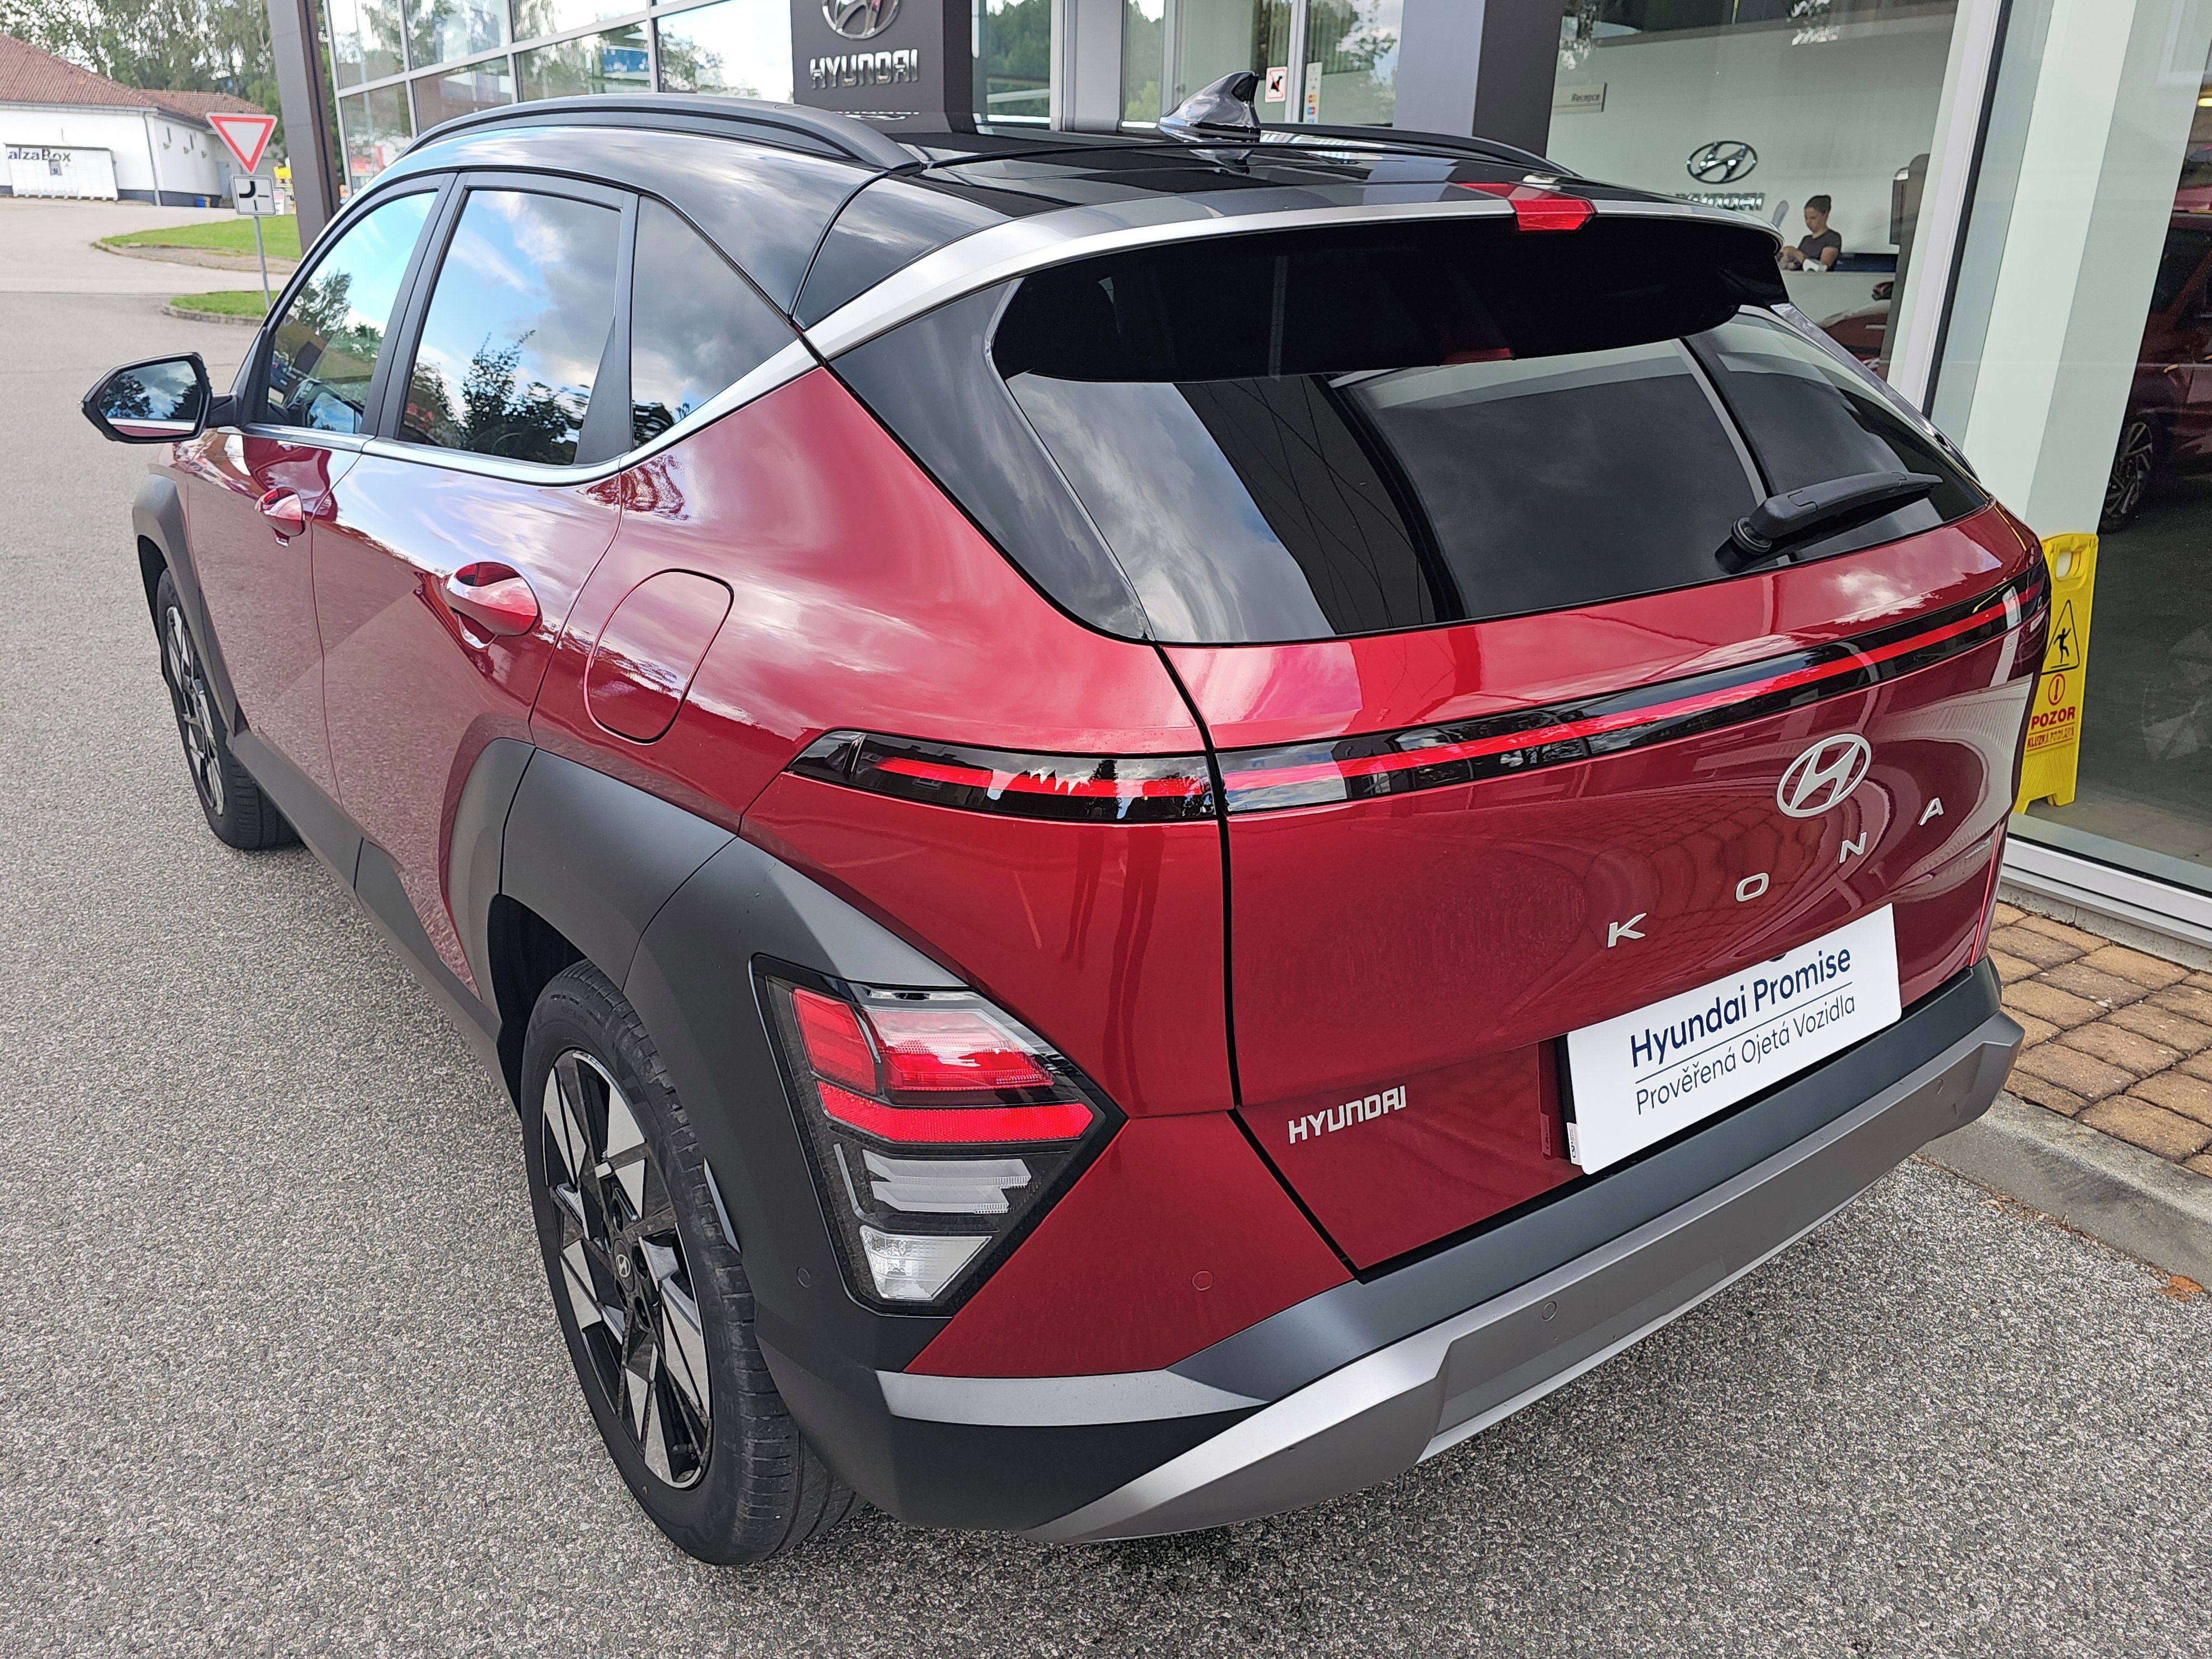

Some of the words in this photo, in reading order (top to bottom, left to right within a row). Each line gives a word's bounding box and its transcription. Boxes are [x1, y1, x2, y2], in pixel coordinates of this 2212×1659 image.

[810, 48, 918, 89] HYUNDAI
[8, 146, 71, 162] alzaBox
[2031, 706, 2076, 730] POZOR
[1607, 797, 1944, 948] KONA
[1630, 984, 1747, 1068] Hyundai
[1754, 948, 1851, 1013] Promise
[1636, 1046, 1736, 1115] Prověřená
[1741, 1021, 1790, 1064] Ojetá
[1793, 994, 1855, 1037] Vozidla
[1288, 1085, 1406, 1144] HYUNDAI
